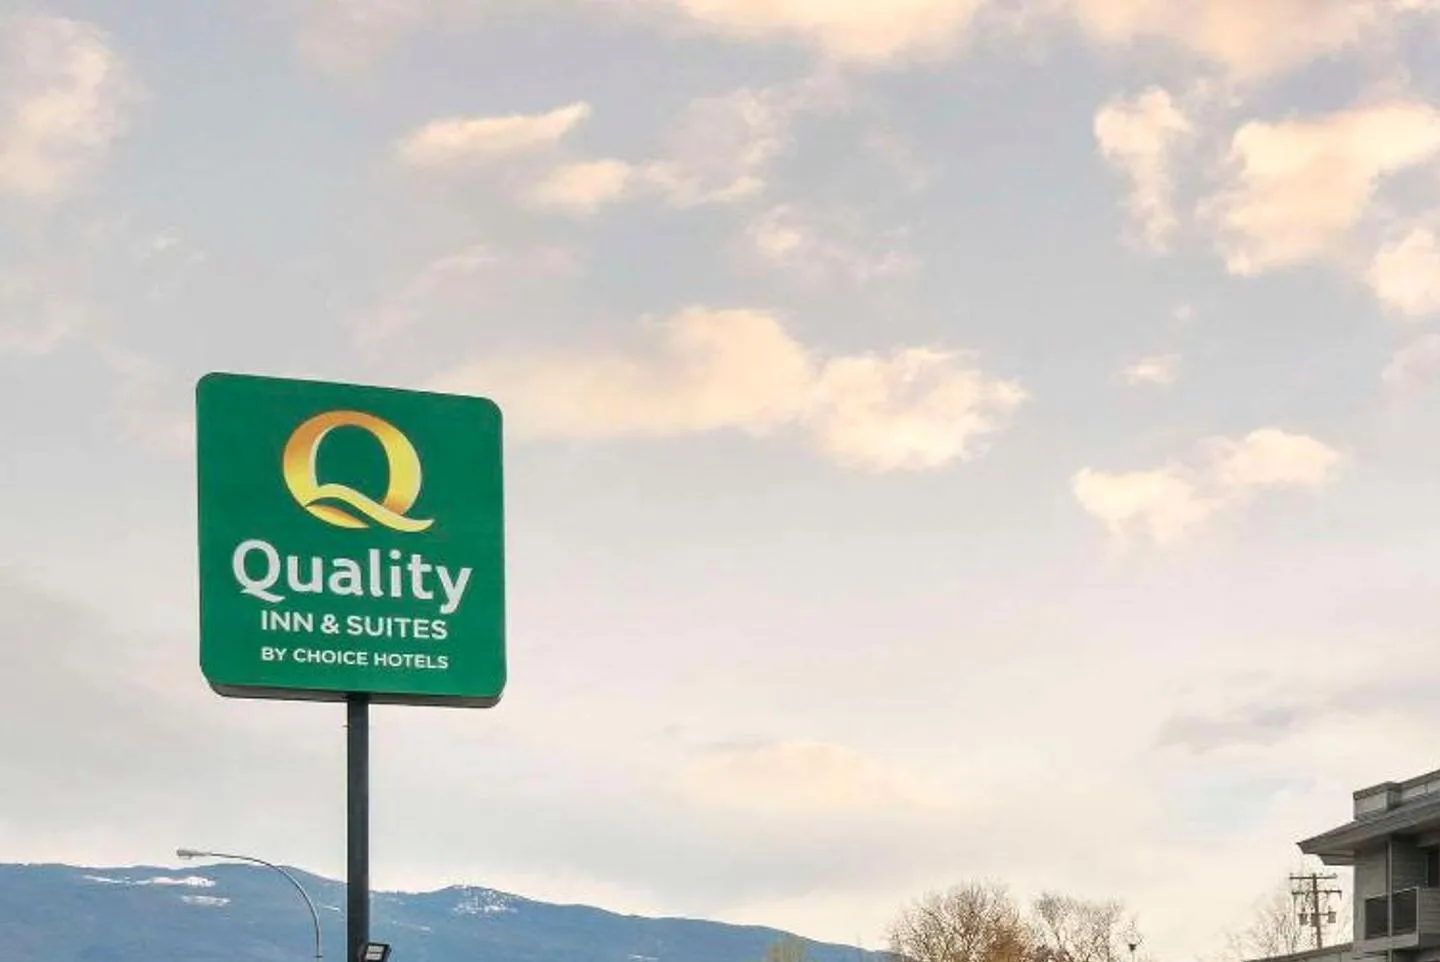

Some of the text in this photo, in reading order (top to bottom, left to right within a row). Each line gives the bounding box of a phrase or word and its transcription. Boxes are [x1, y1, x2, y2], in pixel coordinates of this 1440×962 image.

[282, 410, 434, 532] Q
[232, 539, 473, 614] Quality
[261, 610, 448, 640] INN & SUITES
[261, 646, 449, 669] BY CHOICE HOTELS
